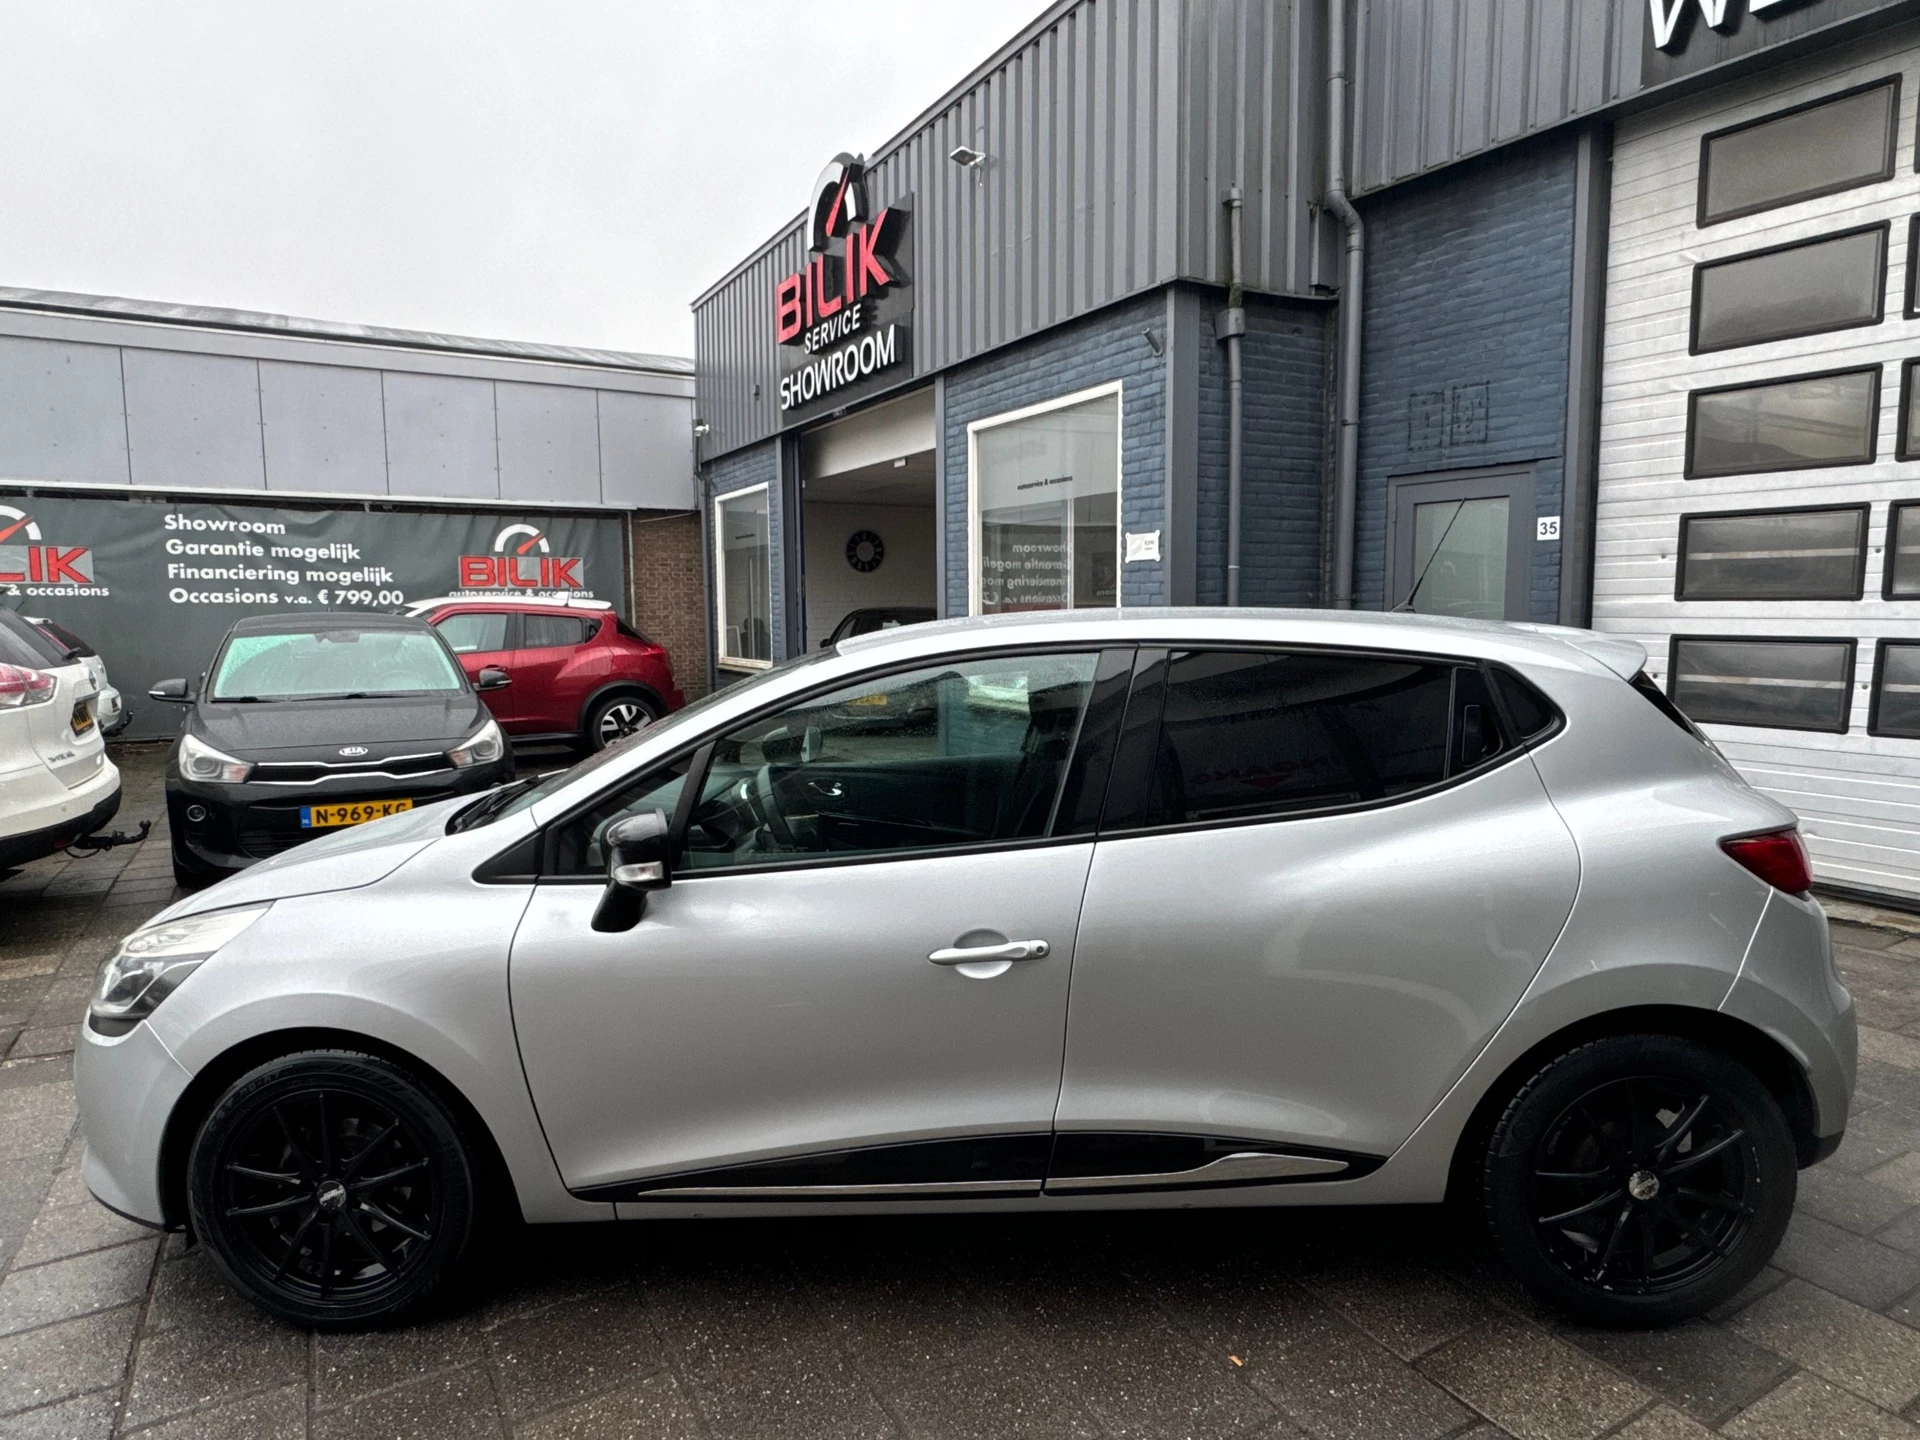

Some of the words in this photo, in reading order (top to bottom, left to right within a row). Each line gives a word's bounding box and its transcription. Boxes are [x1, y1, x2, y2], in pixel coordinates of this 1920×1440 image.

[777, 207, 889, 344] BILIK
[804, 304, 861, 354] SERVICE
[780, 324, 894, 410] SHOWROOM
[164, 514, 286, 535] Showroom
[1540, 521, 1557, 535] 35
[166, 539, 265, 557] Garantie
[271, 543, 361, 563] mogelijk
[0, 546, 94, 583] IK
[168, 563, 300, 585] Financiering
[306, 567, 394, 587] mogelijk
[460, 556, 582, 588] BILIK
[26, 584, 110, 597] occasions
[169, 587, 279, 604] Occasions
[284, 595, 312, 604] v.a.
[317, 589, 329, 605] €
[334, 590, 404, 607] 799,00
[538, 587, 594, 598] occions
[343, 746, 365, 755] KIA
